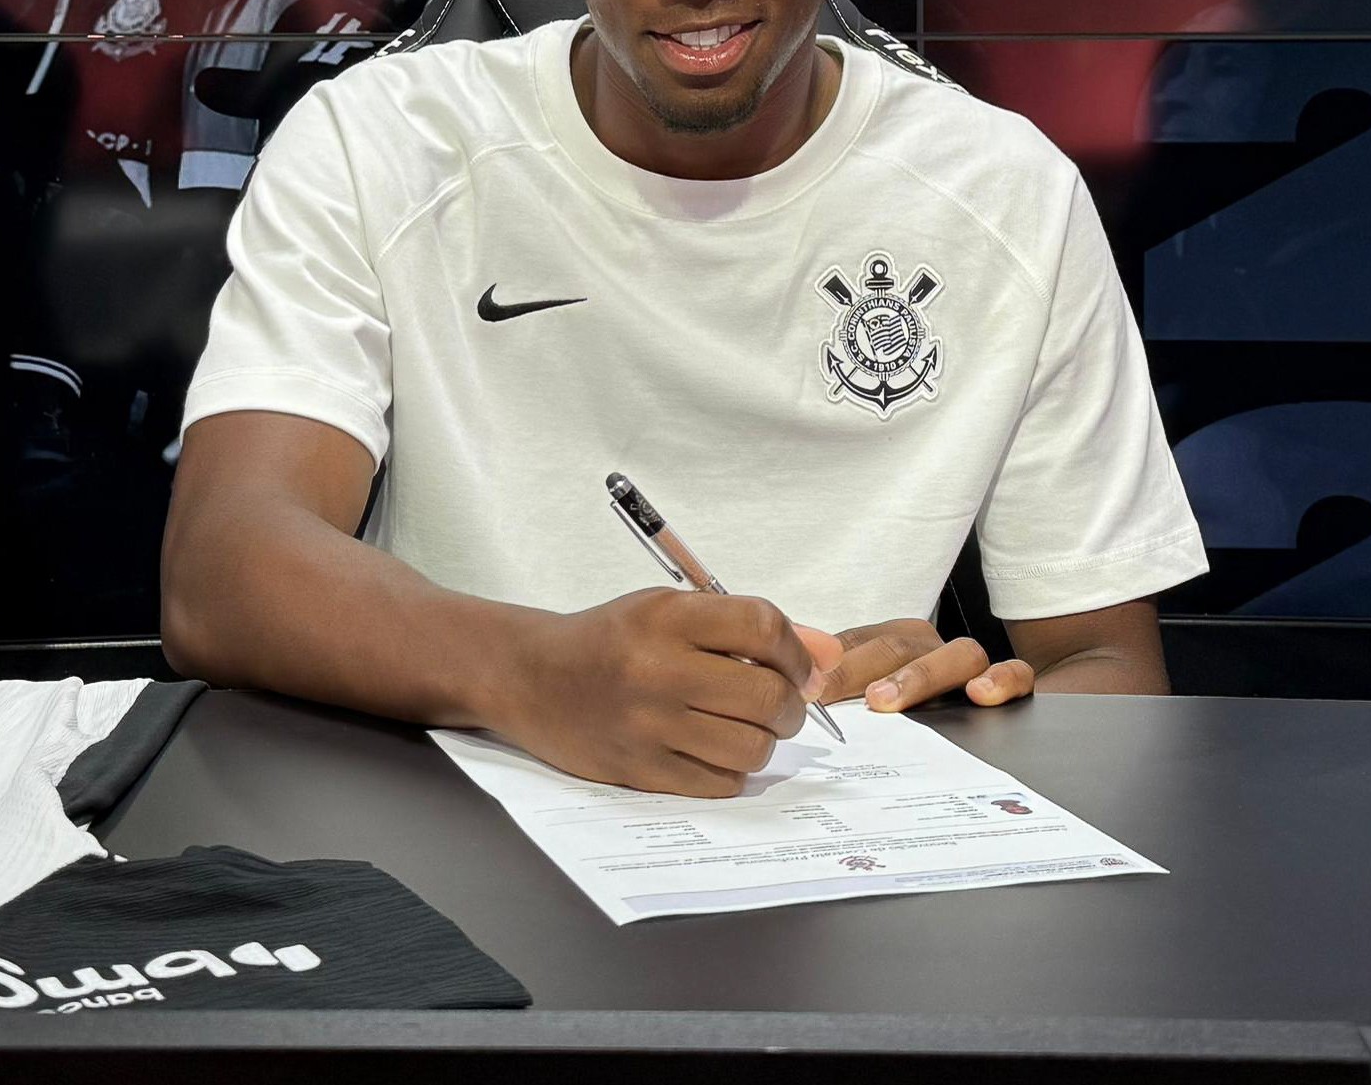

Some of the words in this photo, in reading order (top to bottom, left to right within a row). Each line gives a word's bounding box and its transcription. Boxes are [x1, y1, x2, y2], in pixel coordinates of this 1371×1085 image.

[848, 299, 900, 340] CORINTHIANS
[902, 309, 917, 357] PAULISTA
[874, 363, 896, 371] 1910
